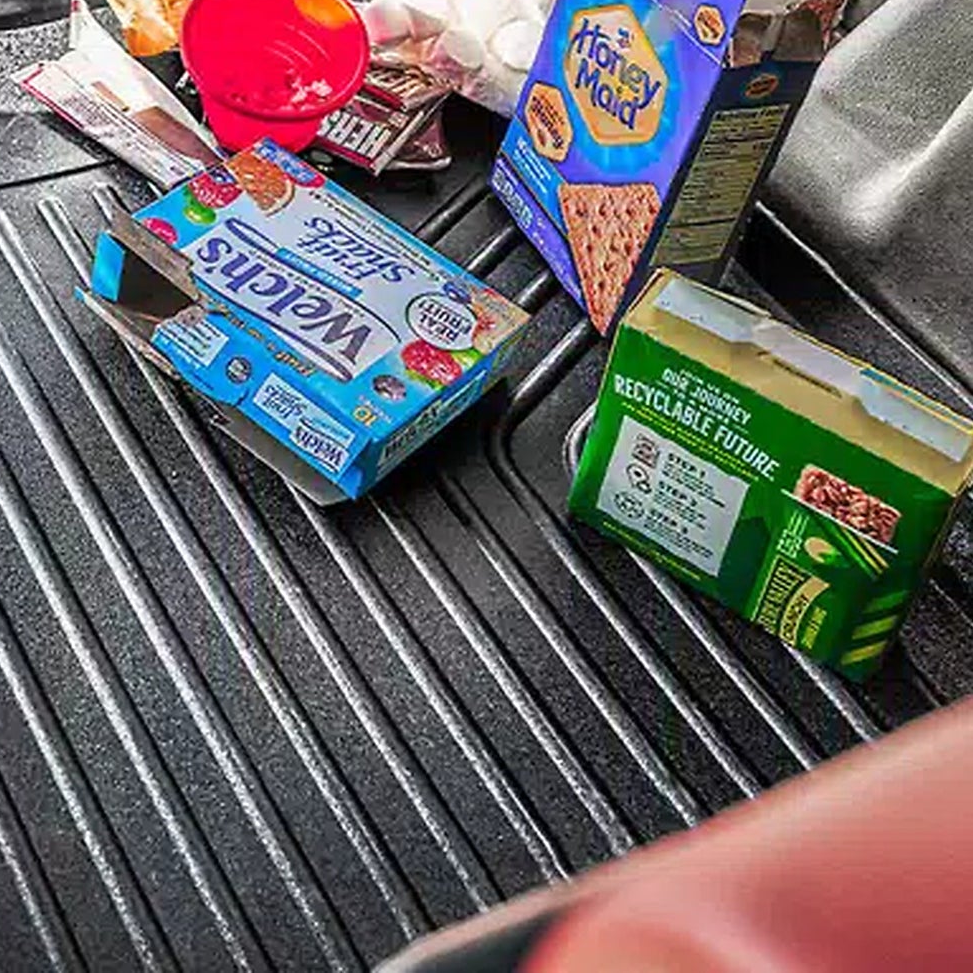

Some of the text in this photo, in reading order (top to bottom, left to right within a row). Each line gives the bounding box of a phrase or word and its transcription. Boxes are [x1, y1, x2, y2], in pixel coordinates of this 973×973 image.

[573, 19, 661, 111] Honey
[576, 59, 639, 130] Maid
[295, 234, 377, 283] Fruit
[195, 235, 374, 366] Welch's
[614, 375, 712, 437] RECYCLABLE
[689, 385, 752, 425] JOURNEY
